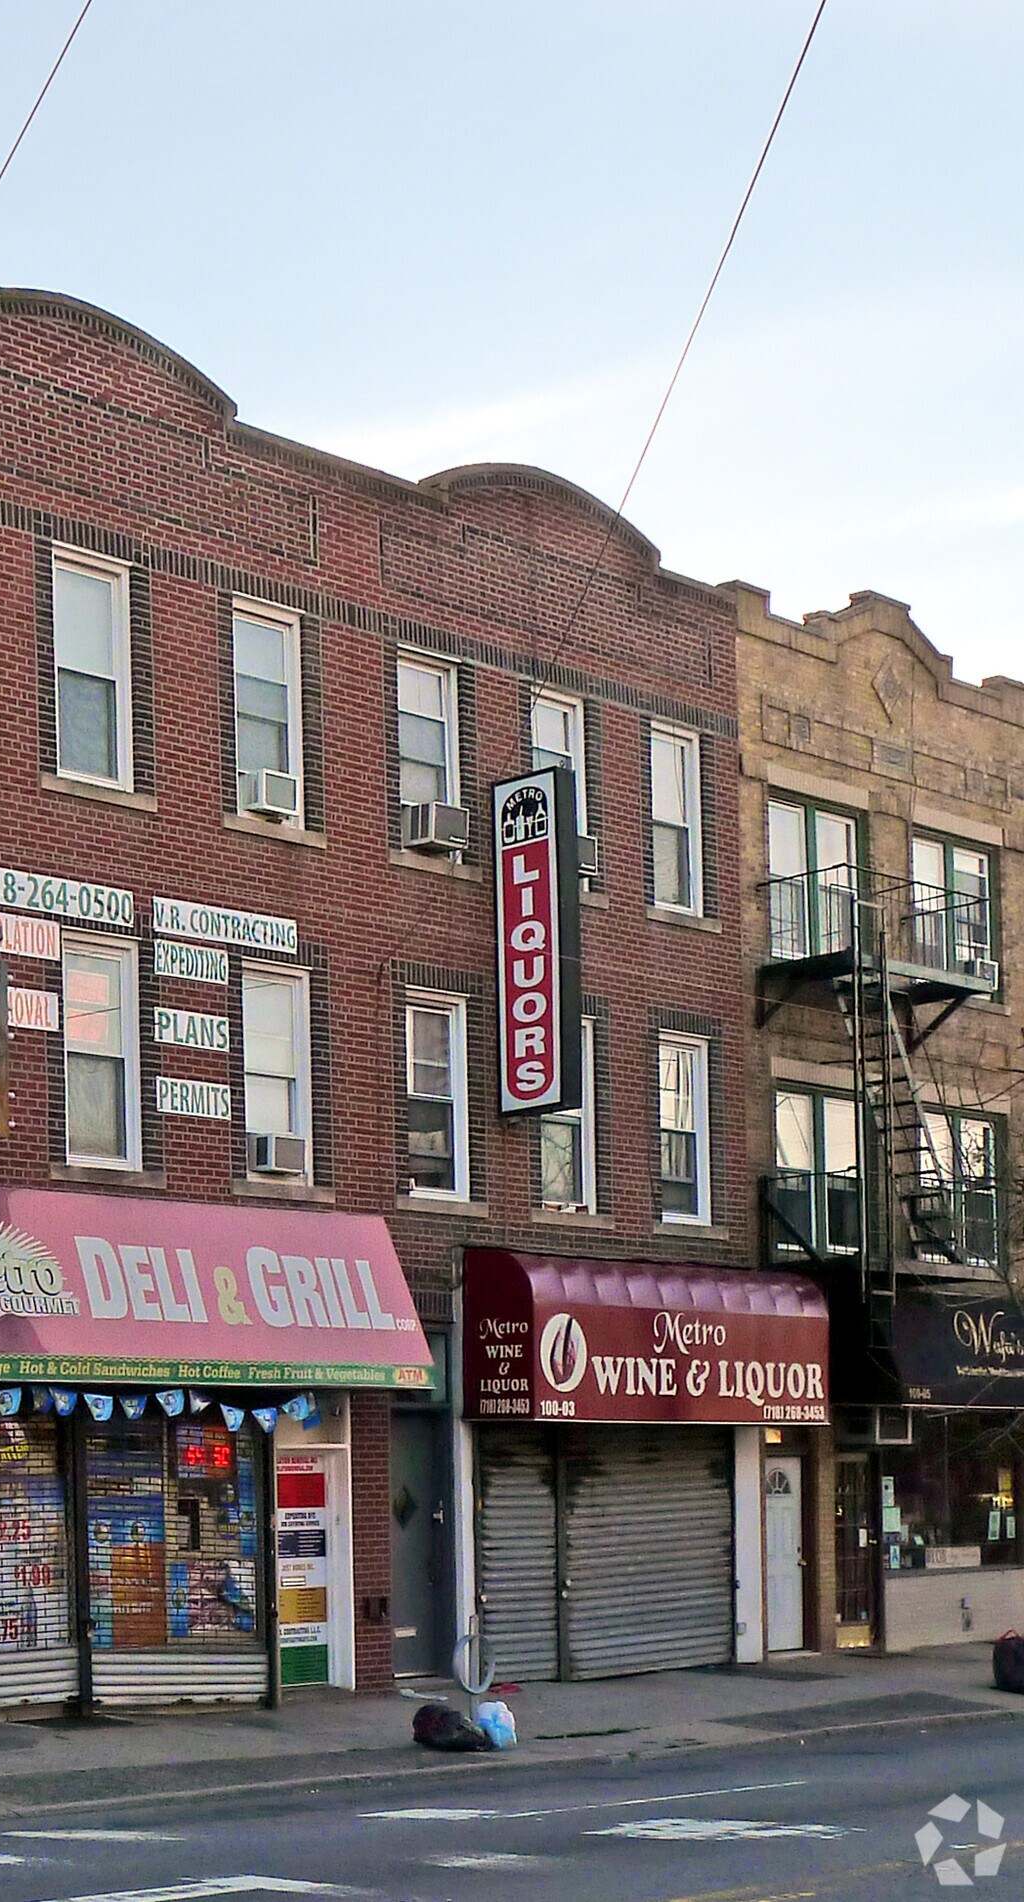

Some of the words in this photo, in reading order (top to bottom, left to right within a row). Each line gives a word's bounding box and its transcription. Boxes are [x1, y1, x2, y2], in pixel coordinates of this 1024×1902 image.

[506, 788, 544, 811] METRO
[154, 902, 186, 931] V.R.
[190, 909, 296, 949] CONTRACTING
[156, 942, 226, 982] EXPEDITING
[510, 854, 547, 1092] LIQUORS
[9, 988, 52, 1027] OVAL
[158, 1012, 228, 1049] PLANS
[160, 1081, 230, 1119] PERMITS
[75, 1236, 209, 1323] DELI
[213, 1266, 252, 1326] &
[246, 1246, 395, 1331] GRILL
[479, 1317, 529, 1340] Metro
[653, 1312, 726, 1355] Metro
[485, 1345, 523, 1359] WINE
[498, 1361, 510, 1376] &
[19, 1361, 45, 1374] Hot
[47, 1362, 58, 1375] &
[60, 1362, 90, 1375] Cold
[93, 1363, 170, 1378] Sandwiches
[178, 1364, 200, 1378] Hot
[203, 1365, 241, 1379] Coffee
[248, 1366, 280, 1380] Fresh
[283, 1366, 313, 1380] Fruit
[314, 1368, 324, 1380] &
[326, 1367, 385, 1384] Vegetables
[398, 1367, 424, 1381] ATM
[480, 1379, 529, 1394] LIQUOR
[592, 1356, 677, 1397] WINE
[686, 1360, 710, 1397] &
[718, 1360, 824, 1406] LIQUOR
[540, 1400, 575, 1417] 100-03
[764, 1404, 784, 1420] (718)
[785, 1405, 825, 1421] 268-3453
